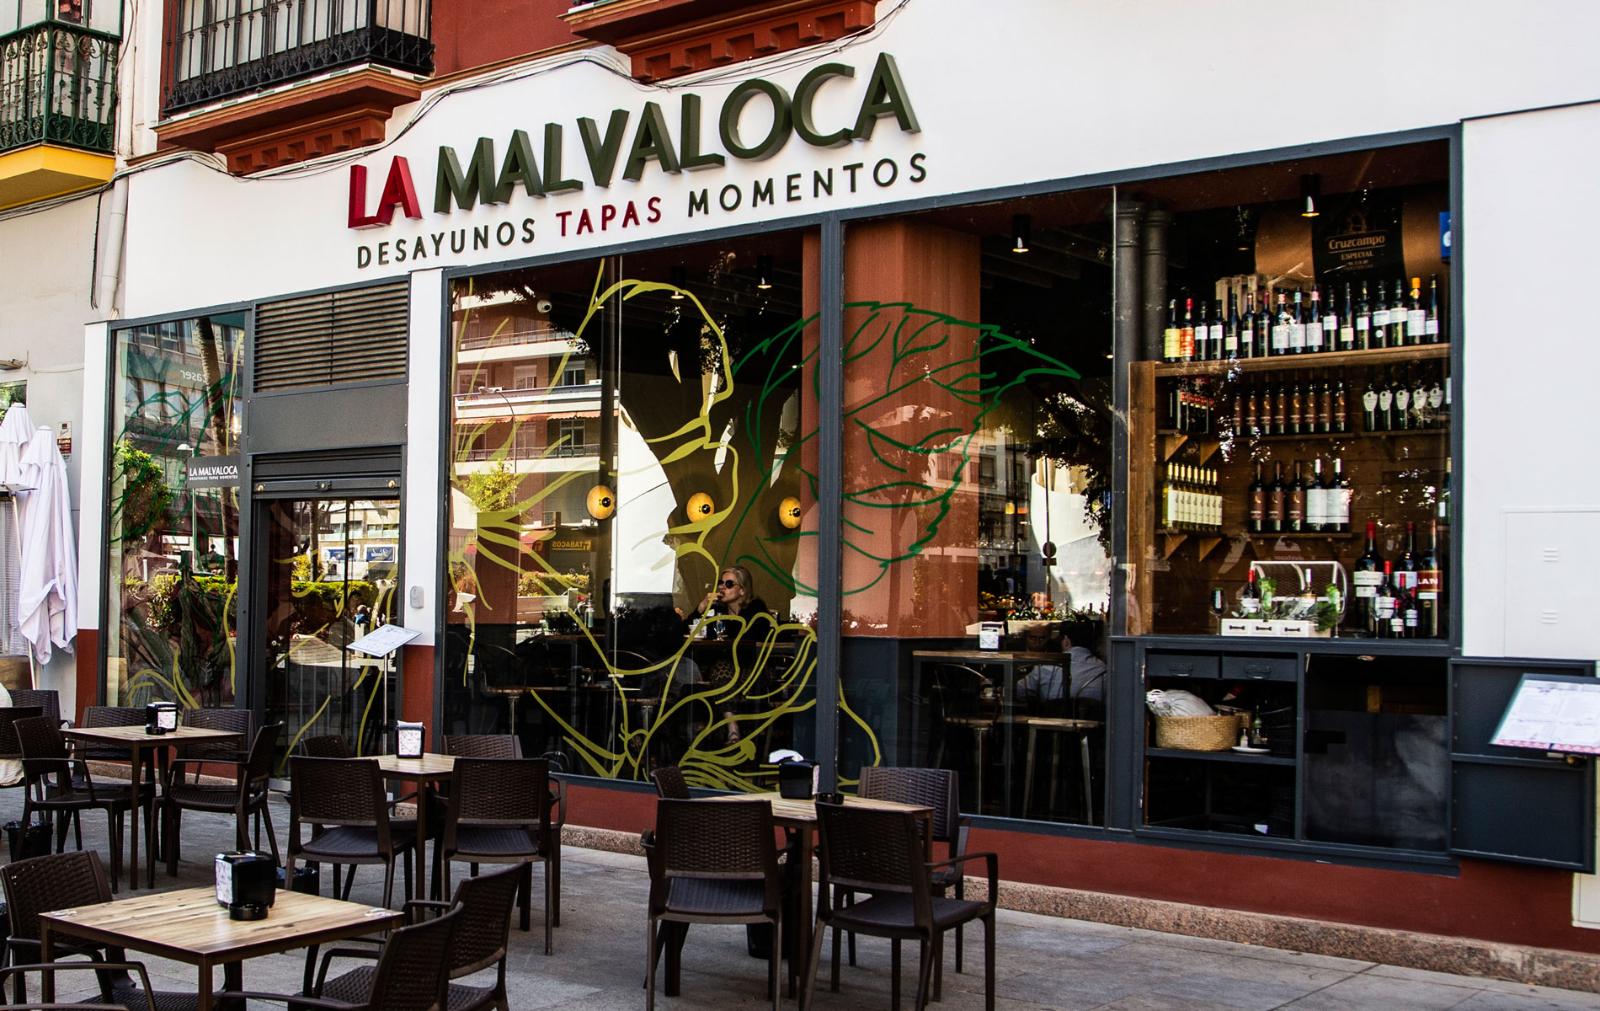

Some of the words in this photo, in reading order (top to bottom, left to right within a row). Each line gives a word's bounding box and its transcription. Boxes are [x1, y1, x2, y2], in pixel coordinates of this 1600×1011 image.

[348, 155, 423, 230] LA
[433, 52, 921, 215] MALVALOCA
[357, 217, 536, 269] DESAYUNOS
[556, 196, 662, 237] TAPAS
[688, 152, 927, 218] MOMENTOS
[1328, 235, 1386, 250] Cruzcampo
[189, 467, 198, 477] LA
[198, 465, 238, 476] MALVALOCA
